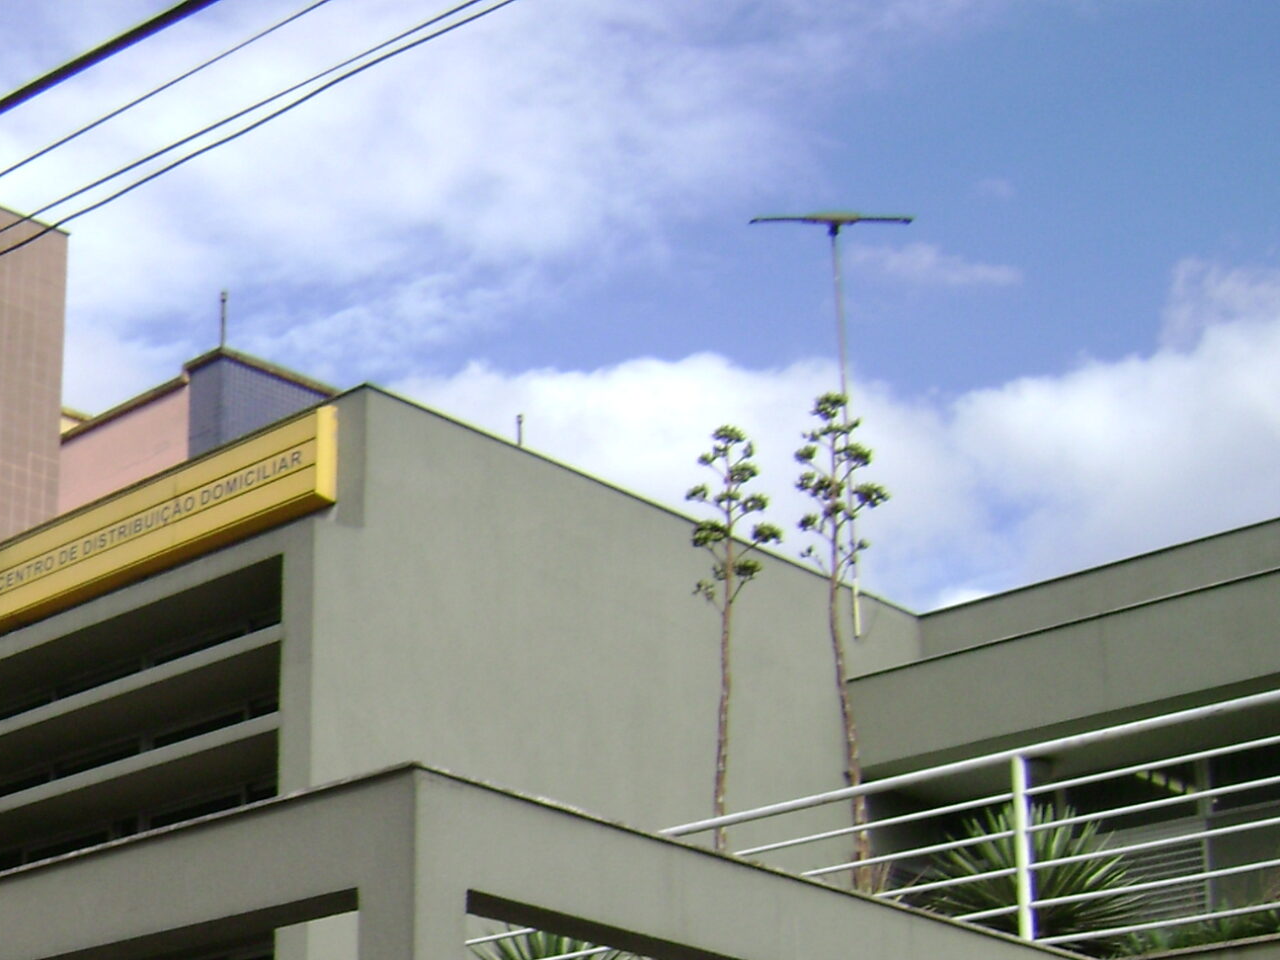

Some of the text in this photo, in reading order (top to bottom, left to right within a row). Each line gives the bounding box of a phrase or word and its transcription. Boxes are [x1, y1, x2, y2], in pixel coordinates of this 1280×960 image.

[57, 545, 78, 566] DE
[82, 493, 196, 556] DISTRIBUIÇÃO
[200, 449, 303, 506] DOMICILIAR
